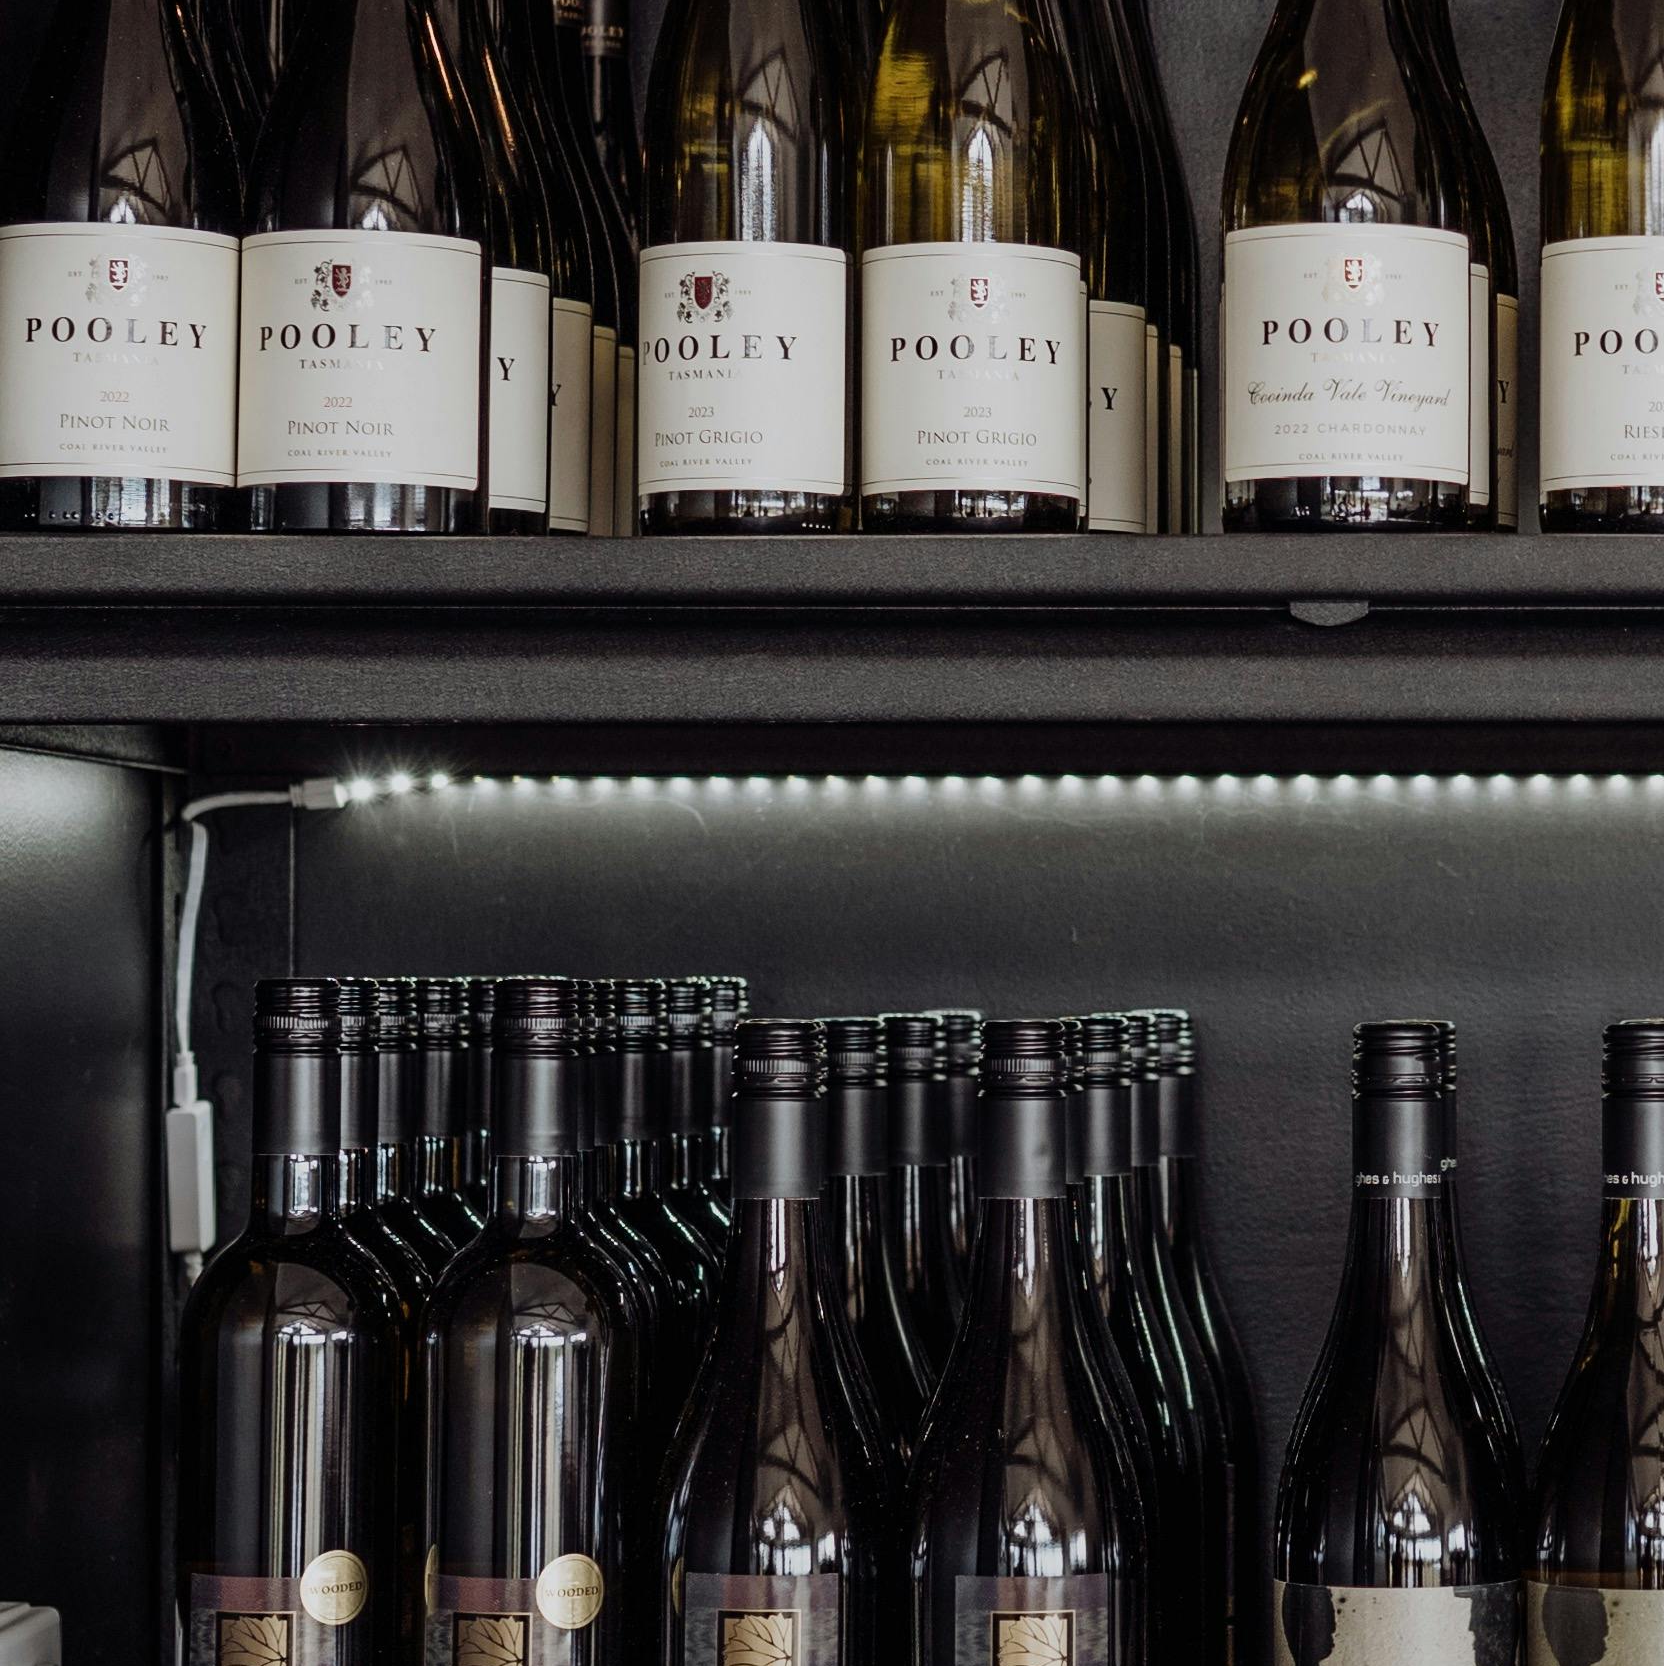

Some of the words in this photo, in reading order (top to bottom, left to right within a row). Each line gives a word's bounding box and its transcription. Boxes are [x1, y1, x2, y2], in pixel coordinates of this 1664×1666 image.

[25, 317, 207, 349] POOLEY
[259, 323, 436, 352] POOLEY
[1262, 318, 1439, 347] POOLEY
[643, 335, 797, 366] POOLEY
[890, 334, 1061, 365] POOLEY
[100, 391, 129, 403] 2022
[323, 397, 353, 408] 2022
[1247, 382, 1314, 405] Cooinda
[1323, 379, 1366, 401] Vale
[1375, 379, 1451, 412] Vineyard
[688, 407, 714, 418] 2023
[963, 407, 992, 418] 2023
[60, 413, 116, 429] PINOT
[122, 415, 170, 432] NOIR
[288, 420, 338, 435] PINOT
[345, 421, 394, 435] NOIR
[1274, 424, 1308, 435] 2022
[1317, 423, 1426, 436] CHARDONNAY
[655, 432, 694, 446] PINOT
[699, 429, 763, 444] GRIGIO
[917, 430, 970, 445] PINOT
[976, 430, 1037, 447] GRIGIO
[60, 443, 86, 451] COAL
[92, 444, 124, 452] RIVER
[130, 445, 167, 453] VALLEY
[353, 450, 392, 458] VALLEY
[1368, 453, 1403, 461] VALLEY
[1393, 1171, 1436, 1187] hughes
[309, 1580, 363, 1596] WOODED
[545, 1585, 600, 1599] WOODED
